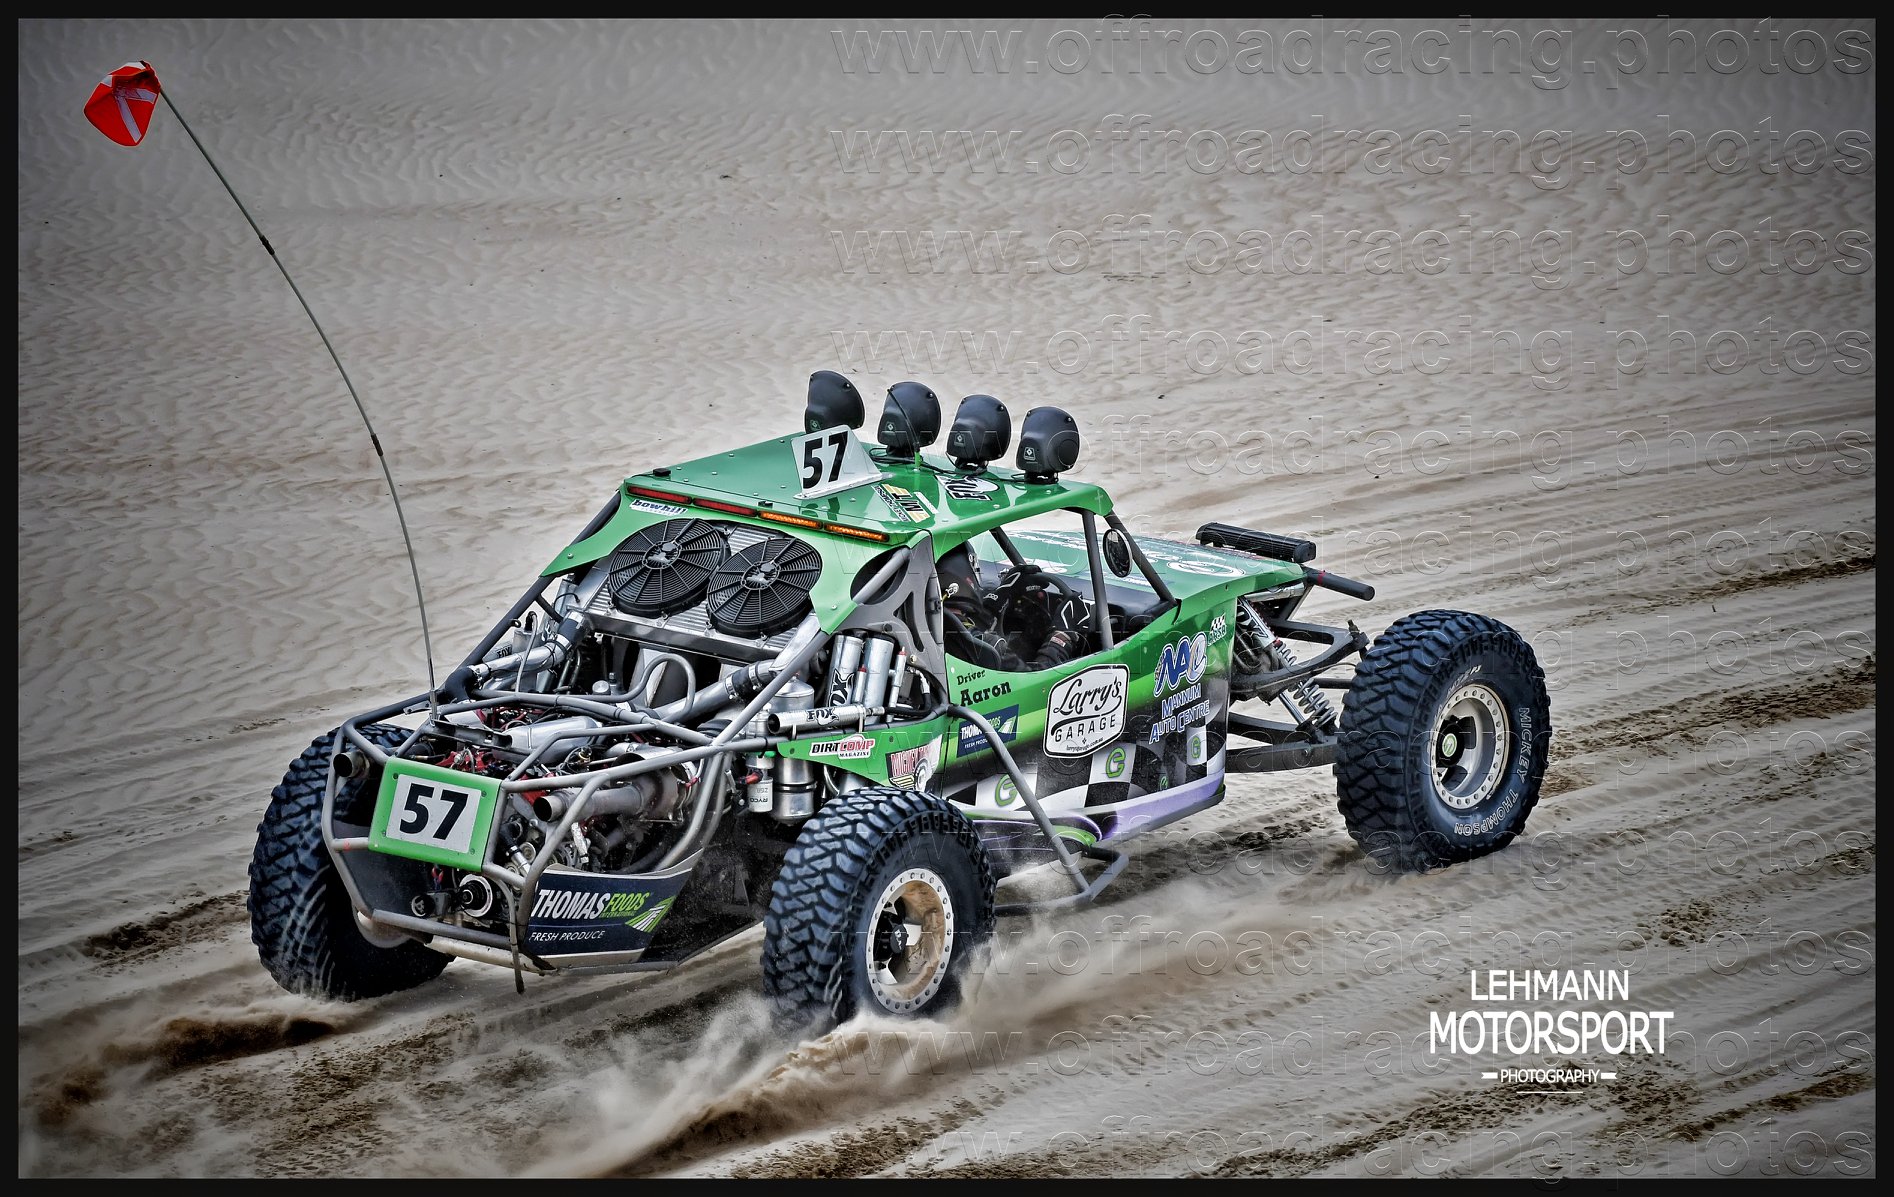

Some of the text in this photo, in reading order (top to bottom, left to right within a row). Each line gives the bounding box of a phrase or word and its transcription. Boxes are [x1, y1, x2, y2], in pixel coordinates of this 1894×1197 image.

[802, 430, 849, 489] 57
[957, 670, 985, 685] Driver
[960, 682, 1012, 706] Aaron
[1053, 676, 1122, 715] Larry's
[806, 707, 836, 720] FOX
[1055, 714, 1116, 742] GARAGE
[1453, 707, 1530, 836] MICKEY THOMPSON
[400, 783, 469, 840] 57
[530, 889, 650, 920] THOMAS FOODS
[528, 930, 605, 941] FRESH PRODUCE
